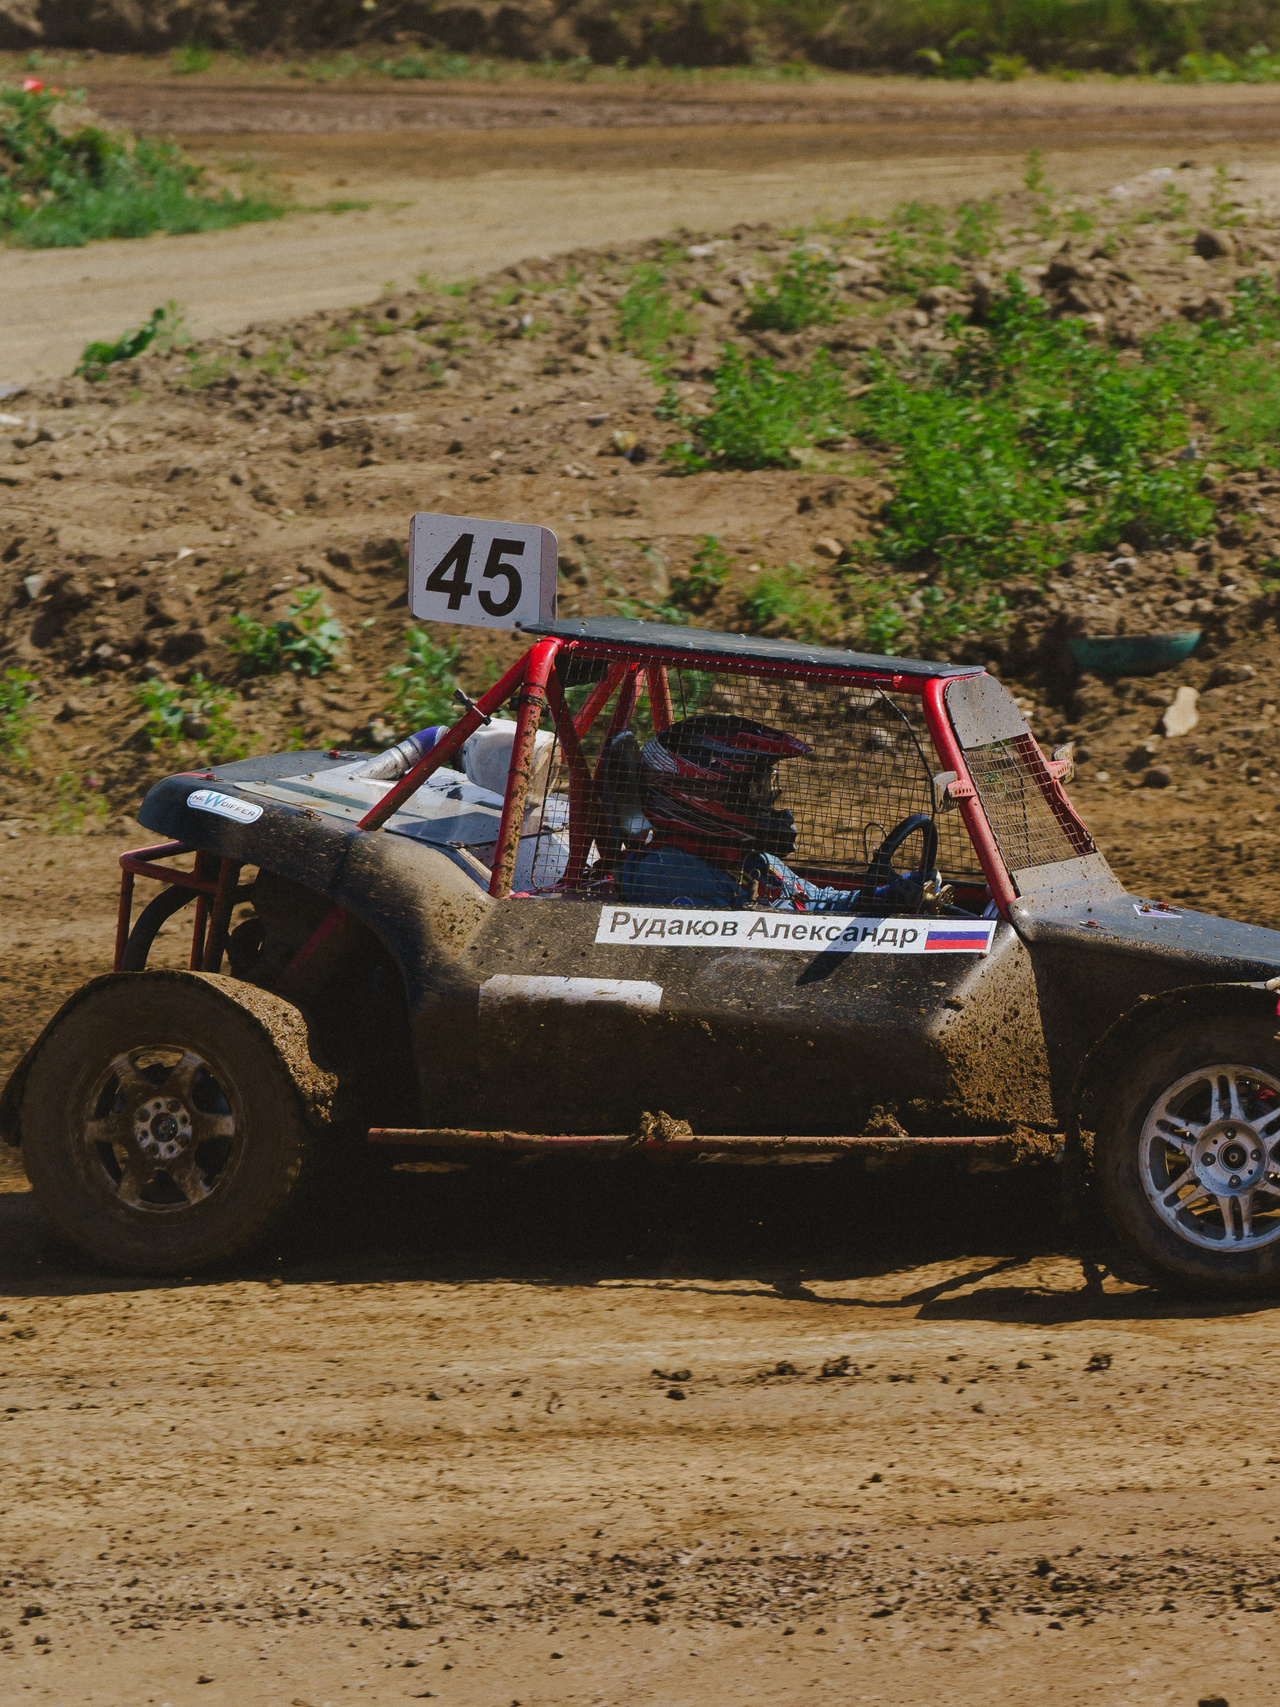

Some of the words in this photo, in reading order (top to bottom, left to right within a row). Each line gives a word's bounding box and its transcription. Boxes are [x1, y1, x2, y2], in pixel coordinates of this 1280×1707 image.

[425, 533, 526, 617] 45
[610, 912, 738, 940] Рудаков
[747, 917, 919, 948] Александр
